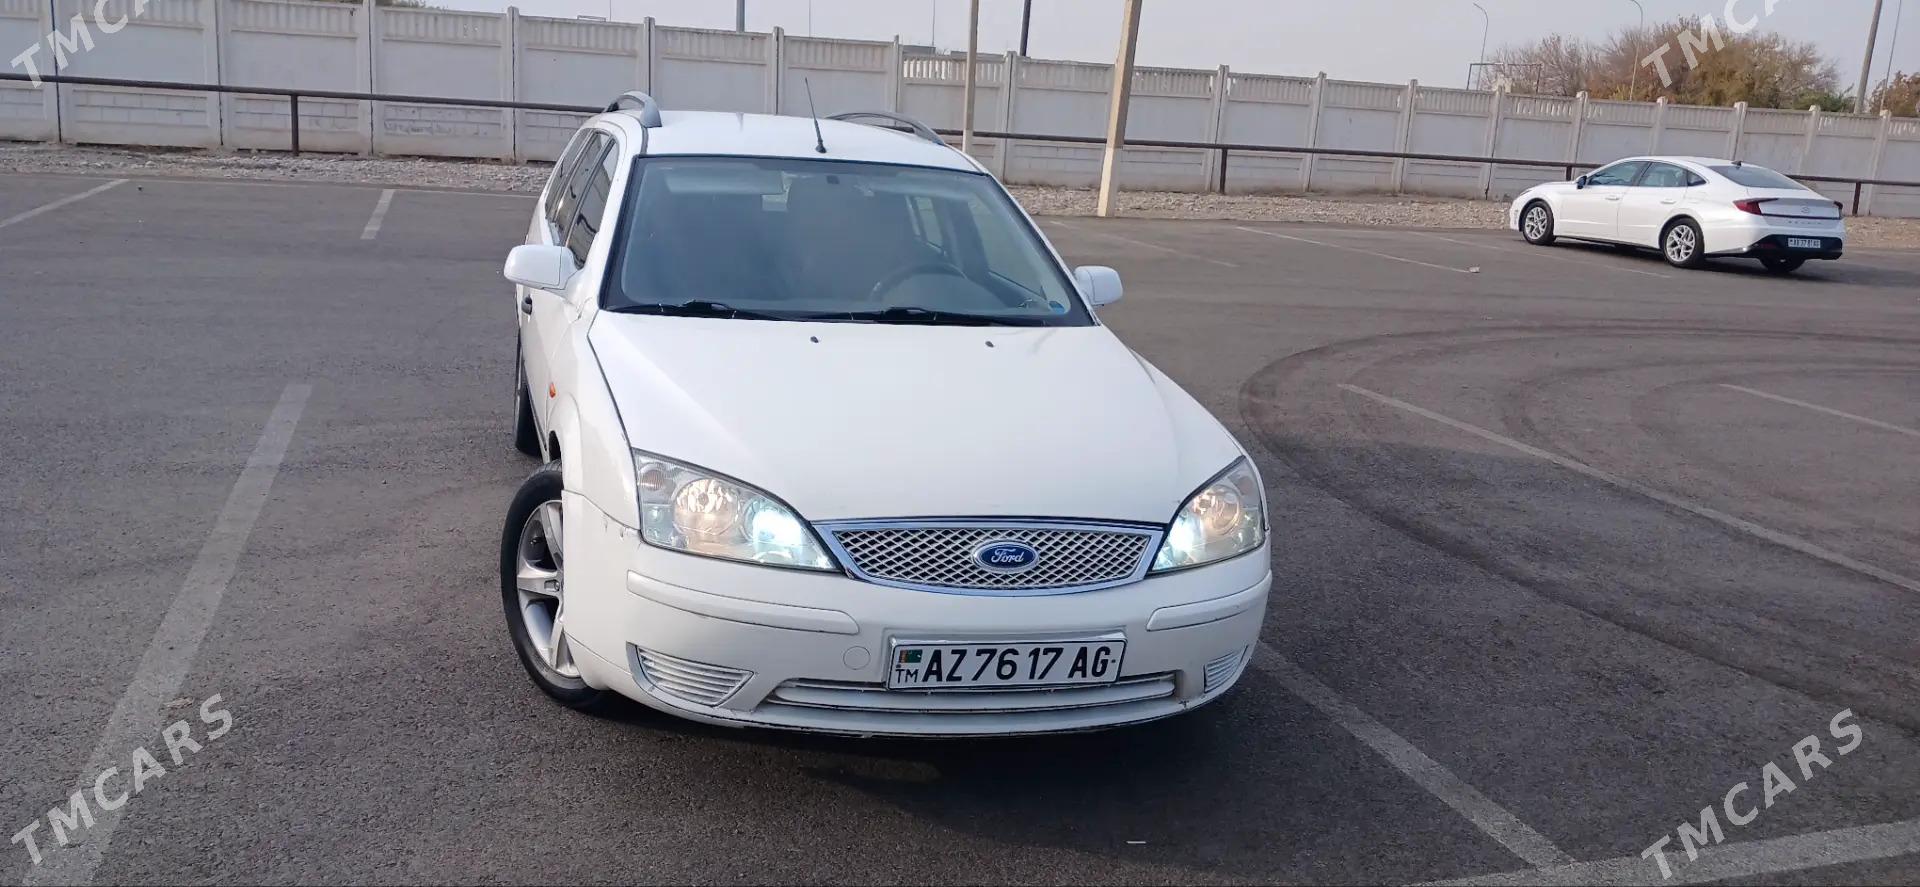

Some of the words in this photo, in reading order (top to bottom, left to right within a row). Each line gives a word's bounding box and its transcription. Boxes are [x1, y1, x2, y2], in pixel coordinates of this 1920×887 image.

[991, 548, 1024, 563] Ford
[1067, 646, 1111, 679] AG
[895, 668, 918, 684] TM
